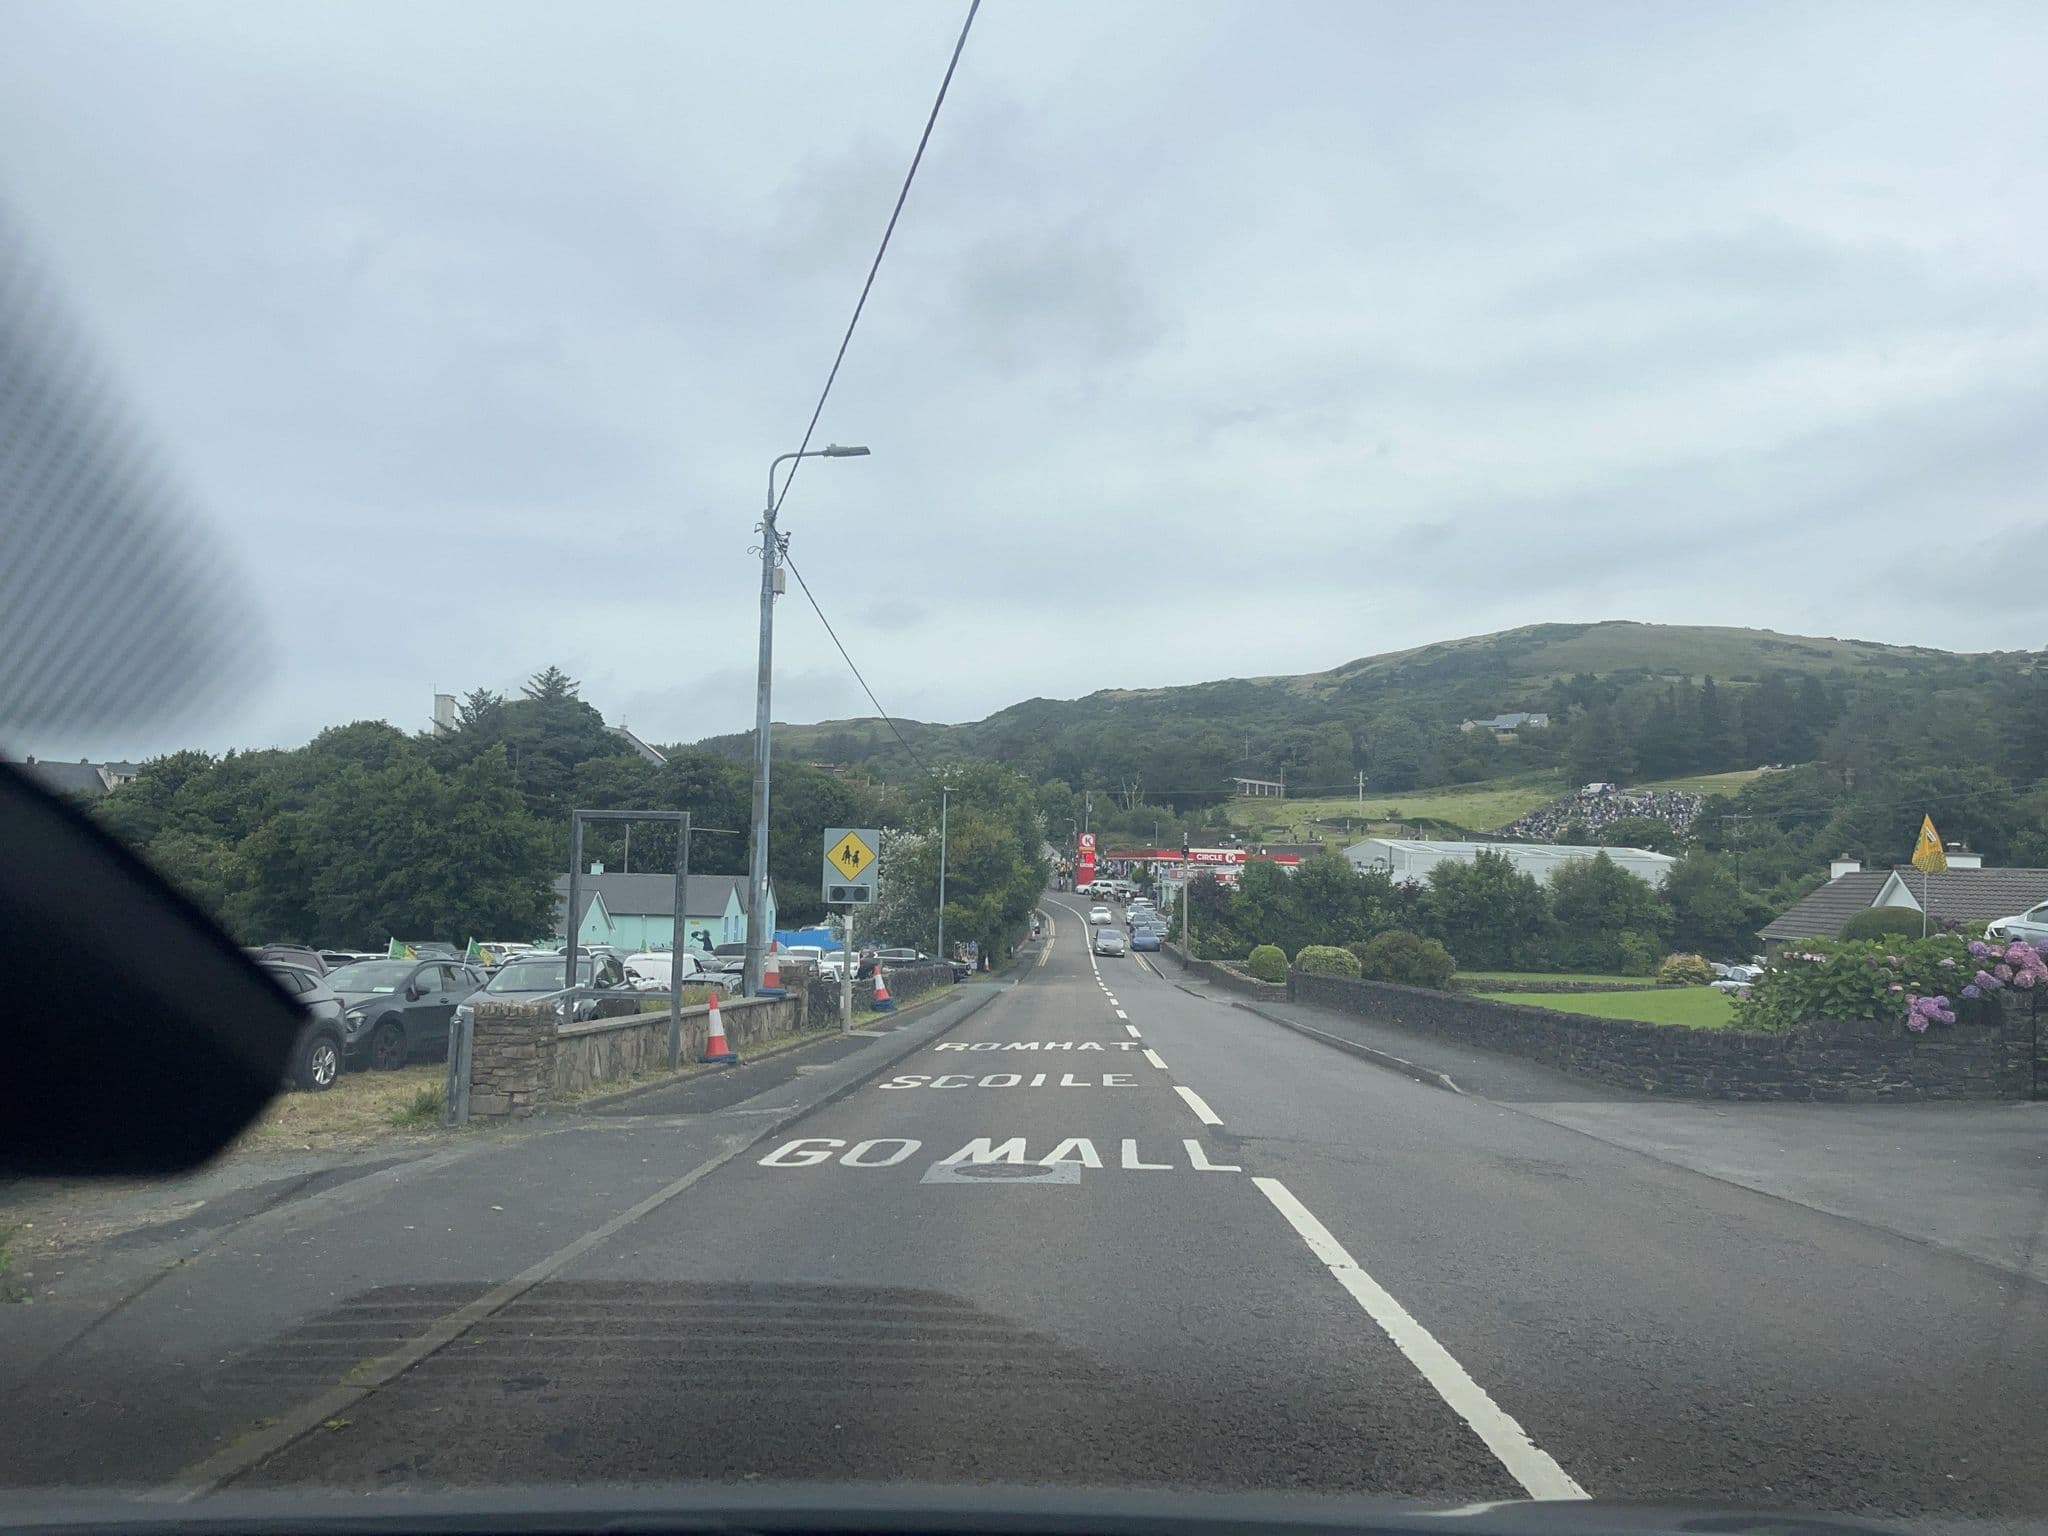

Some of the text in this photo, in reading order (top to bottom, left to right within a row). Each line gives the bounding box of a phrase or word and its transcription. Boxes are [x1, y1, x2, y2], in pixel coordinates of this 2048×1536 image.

[1196, 853, 1223, 862] CIRCLE
[934, 1041, 1139, 1051] ROMHAT
[879, 1073, 1139, 1089] SCOILE
[758, 1137, 1242, 1173] GO MALL
